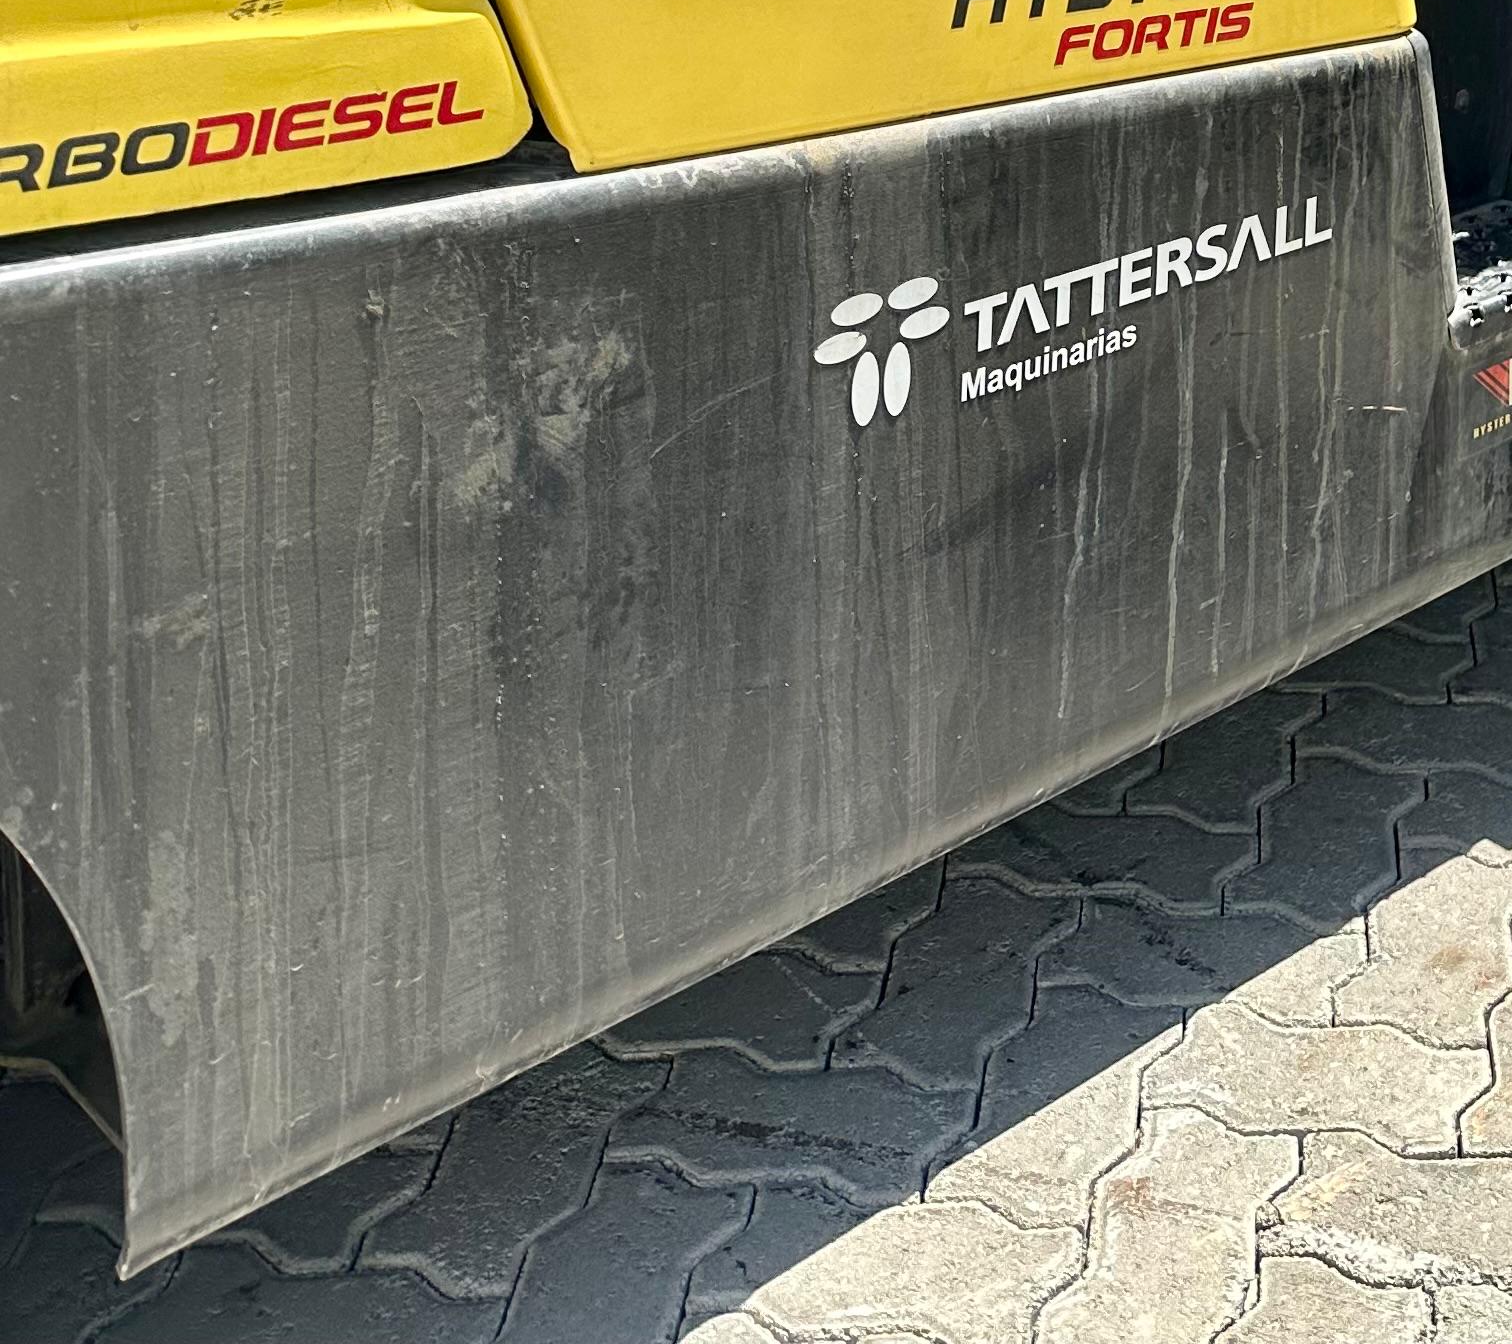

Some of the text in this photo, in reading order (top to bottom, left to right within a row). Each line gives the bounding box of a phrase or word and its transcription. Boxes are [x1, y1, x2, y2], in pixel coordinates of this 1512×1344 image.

[1053, 2, 1255, 66] FORTIS
[964, 195, 1334, 354] TATTERSALL
[960, 320, 1139, 404] Maquinarias
[1473, 413, 1511, 440] HYSTER
